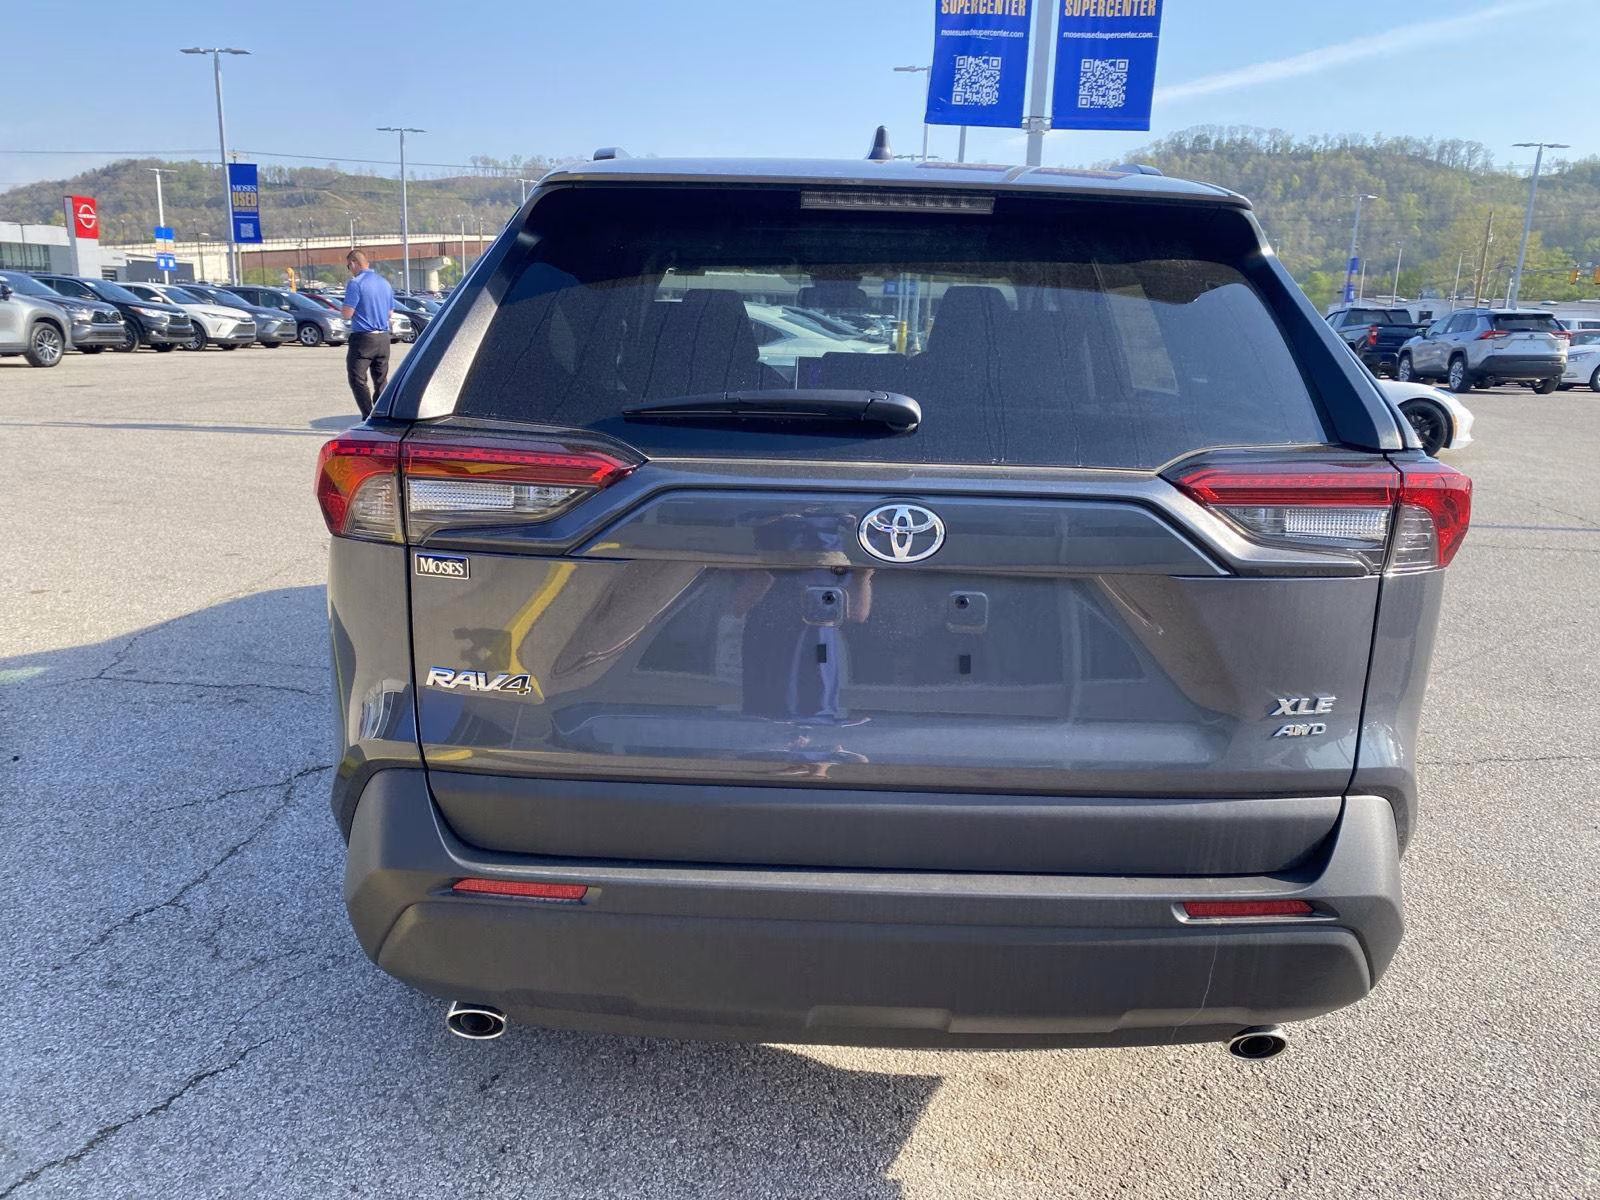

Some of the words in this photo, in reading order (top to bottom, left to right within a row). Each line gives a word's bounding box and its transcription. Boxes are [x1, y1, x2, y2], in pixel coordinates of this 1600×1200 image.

[941, 0, 1026, 16] SUPERCENTER
[1065, 0, 1157, 17] SUPERCENTER
[1063, 31, 1153, 40] mosesusedsupercenter.com
[232, 184, 257, 192] MOSES
[233, 192, 257, 207] USED
[419, 557, 464, 576] MOSES
[425, 666, 532, 696] RAV4
[1270, 696, 1337, 716] XLE
[1272, 722, 1327, 737] AWD
